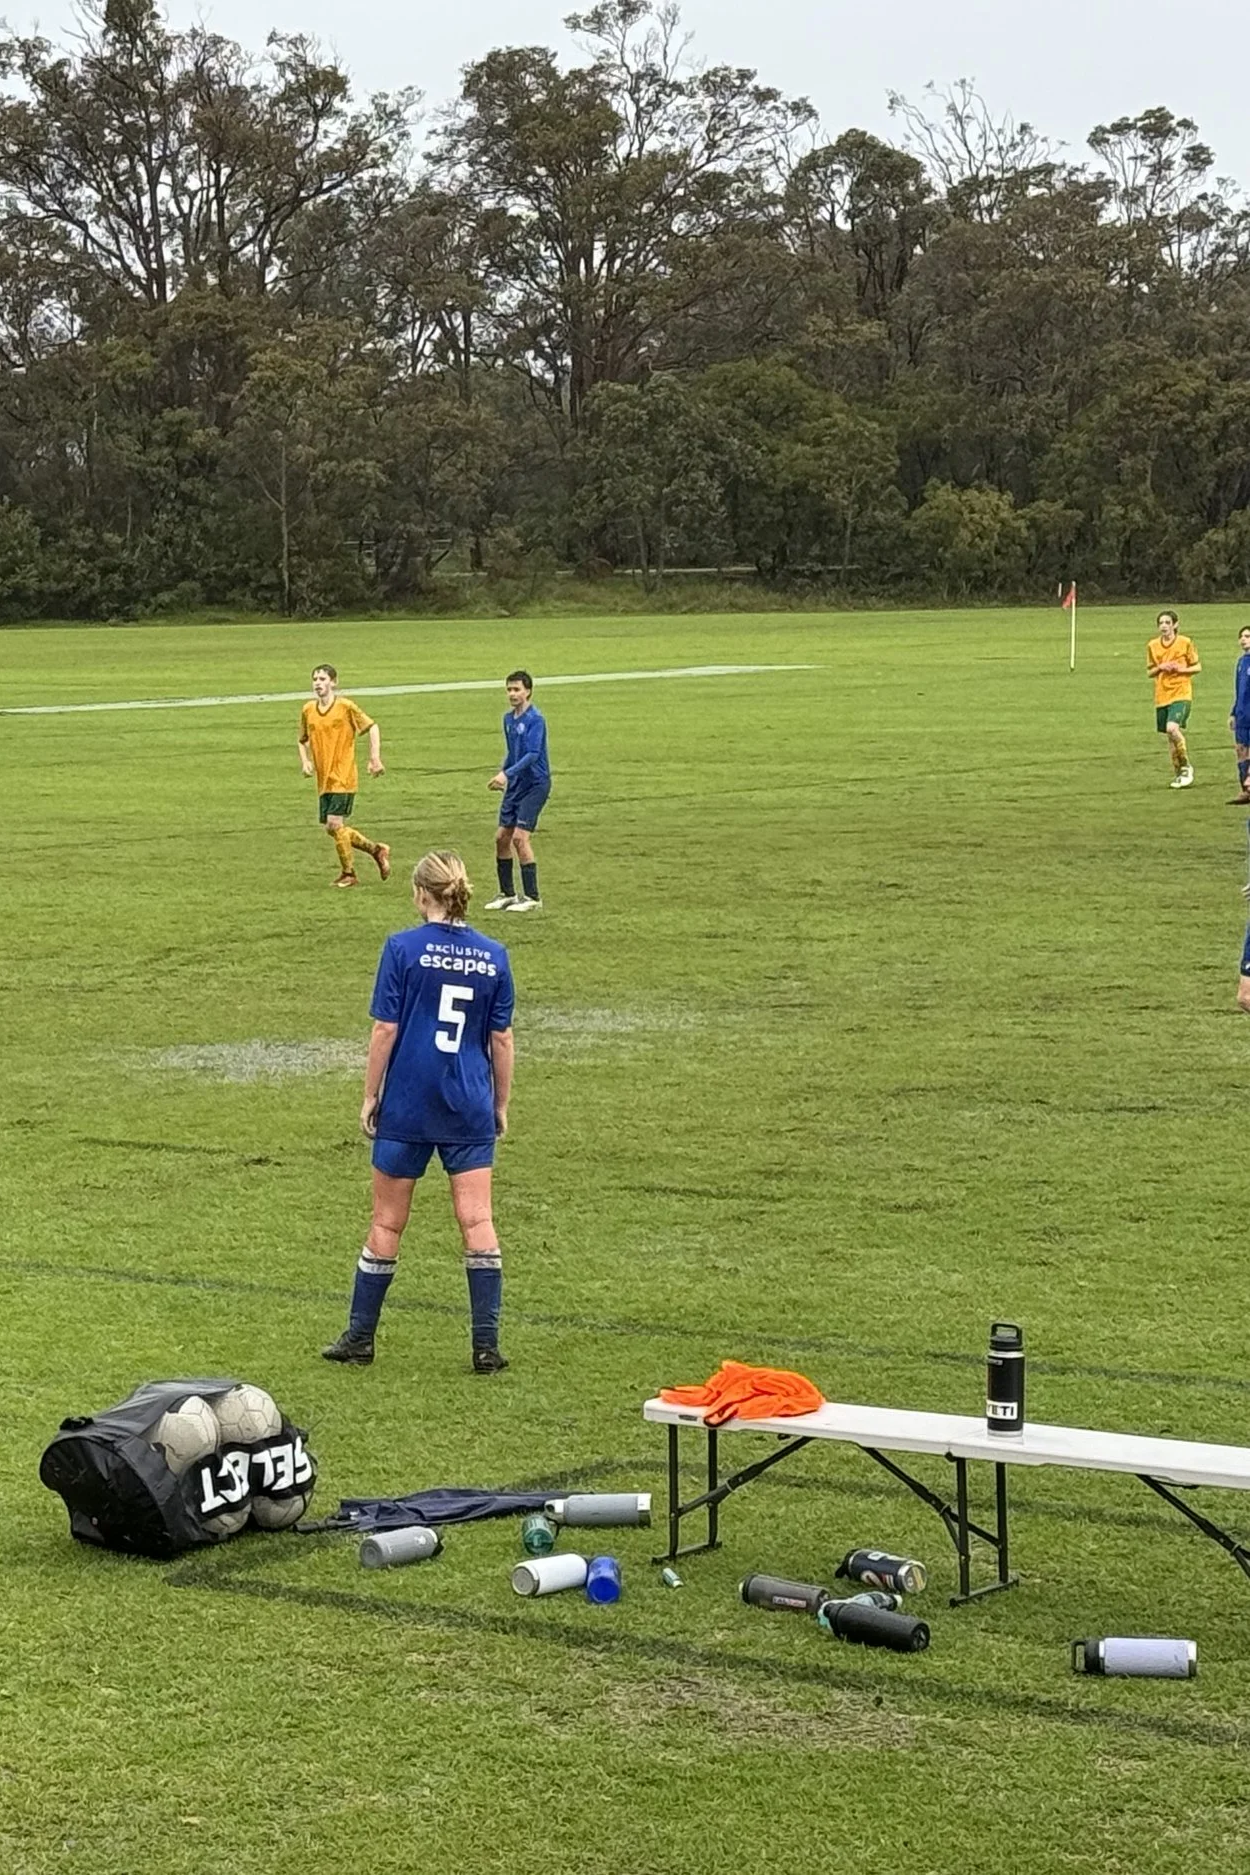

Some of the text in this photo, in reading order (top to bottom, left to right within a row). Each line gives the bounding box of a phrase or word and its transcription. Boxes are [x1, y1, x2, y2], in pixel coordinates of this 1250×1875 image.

[419, 954, 497, 977] escapes
[425, 942, 492, 961] exclusive
[435, 983, 474, 1054] 5
[200, 1436, 313, 1514] SELECT
